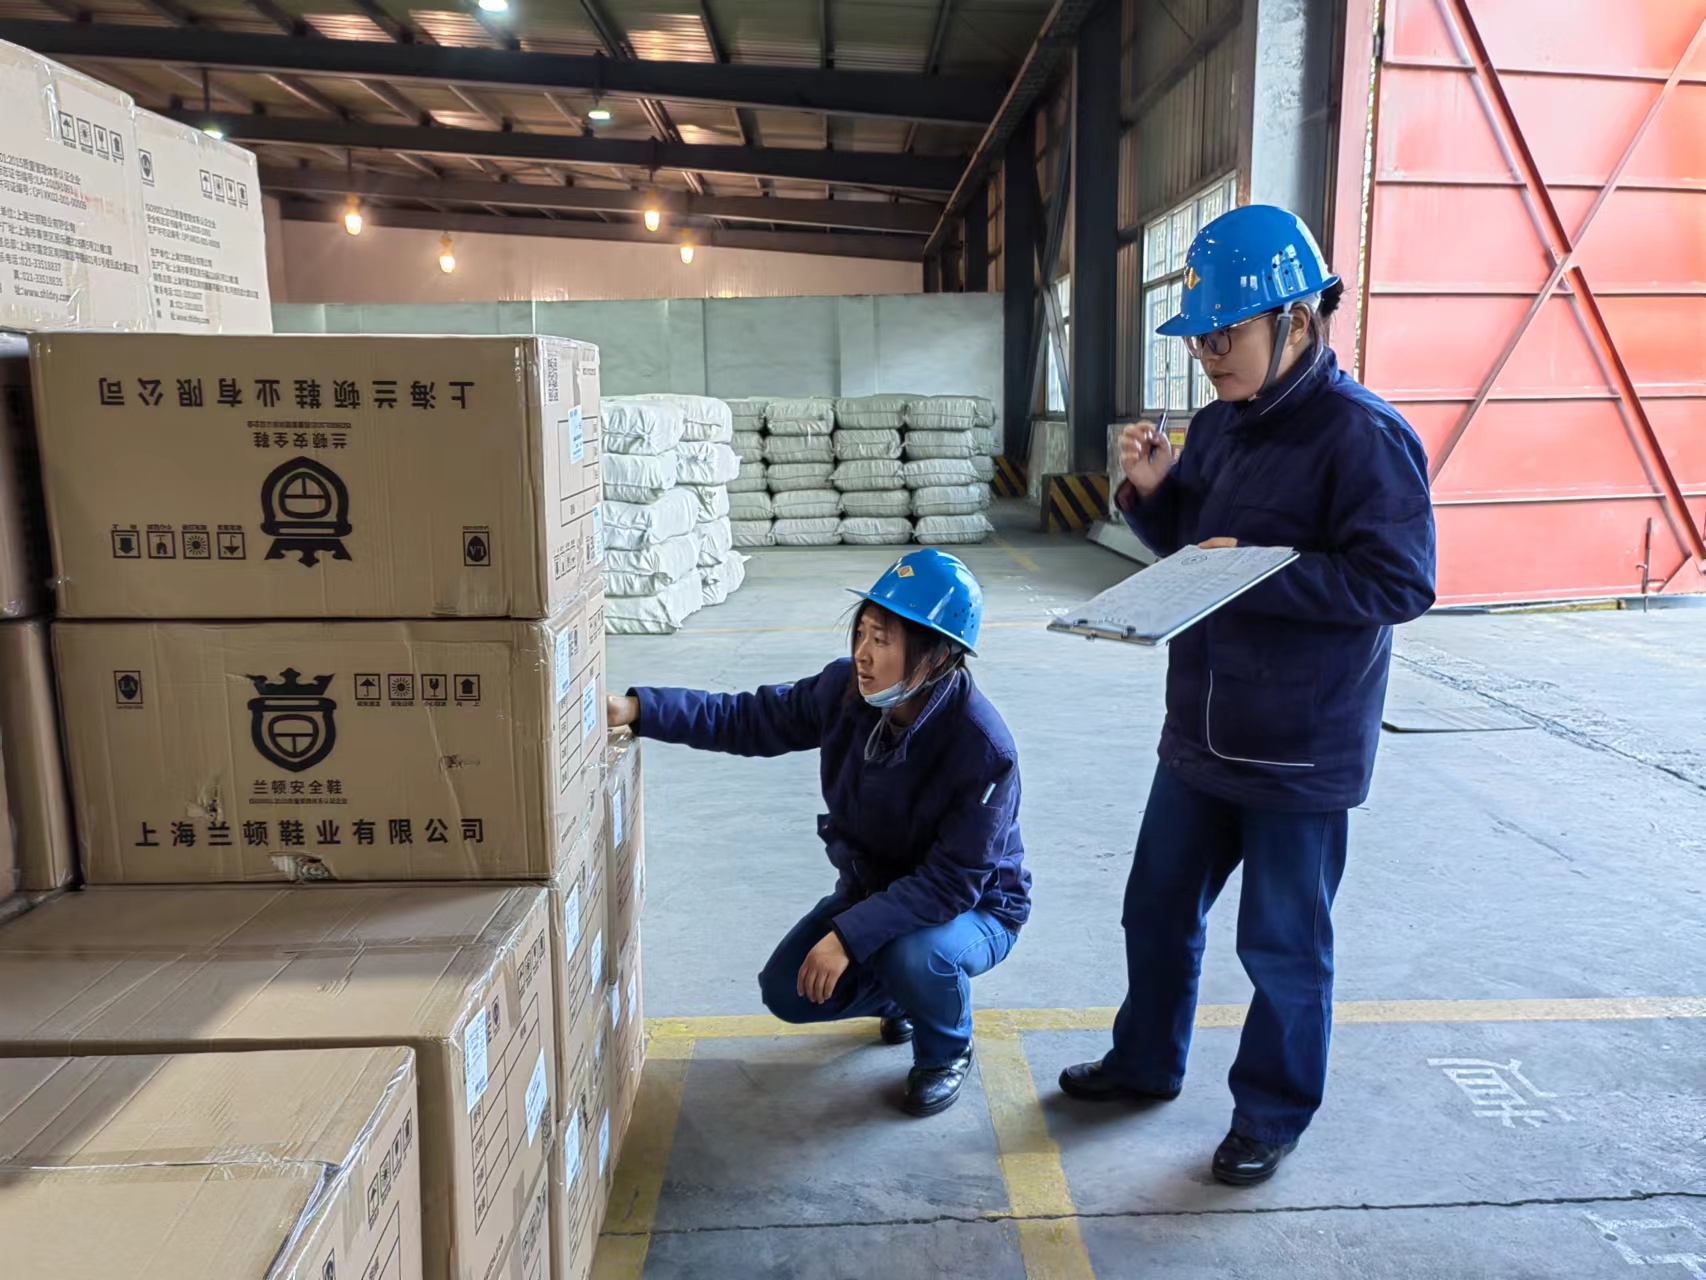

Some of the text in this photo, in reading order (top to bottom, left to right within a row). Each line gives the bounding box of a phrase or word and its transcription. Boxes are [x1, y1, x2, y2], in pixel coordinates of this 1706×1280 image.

[99, 377, 475, 411] 上海兰顿鞋业有限公司
[252, 432, 348, 449] 兰顿安全鞋
[253, 779, 343, 795] 兰顿安全鞋
[135, 817, 484, 848] 上海兰顿鞋业有限公司
